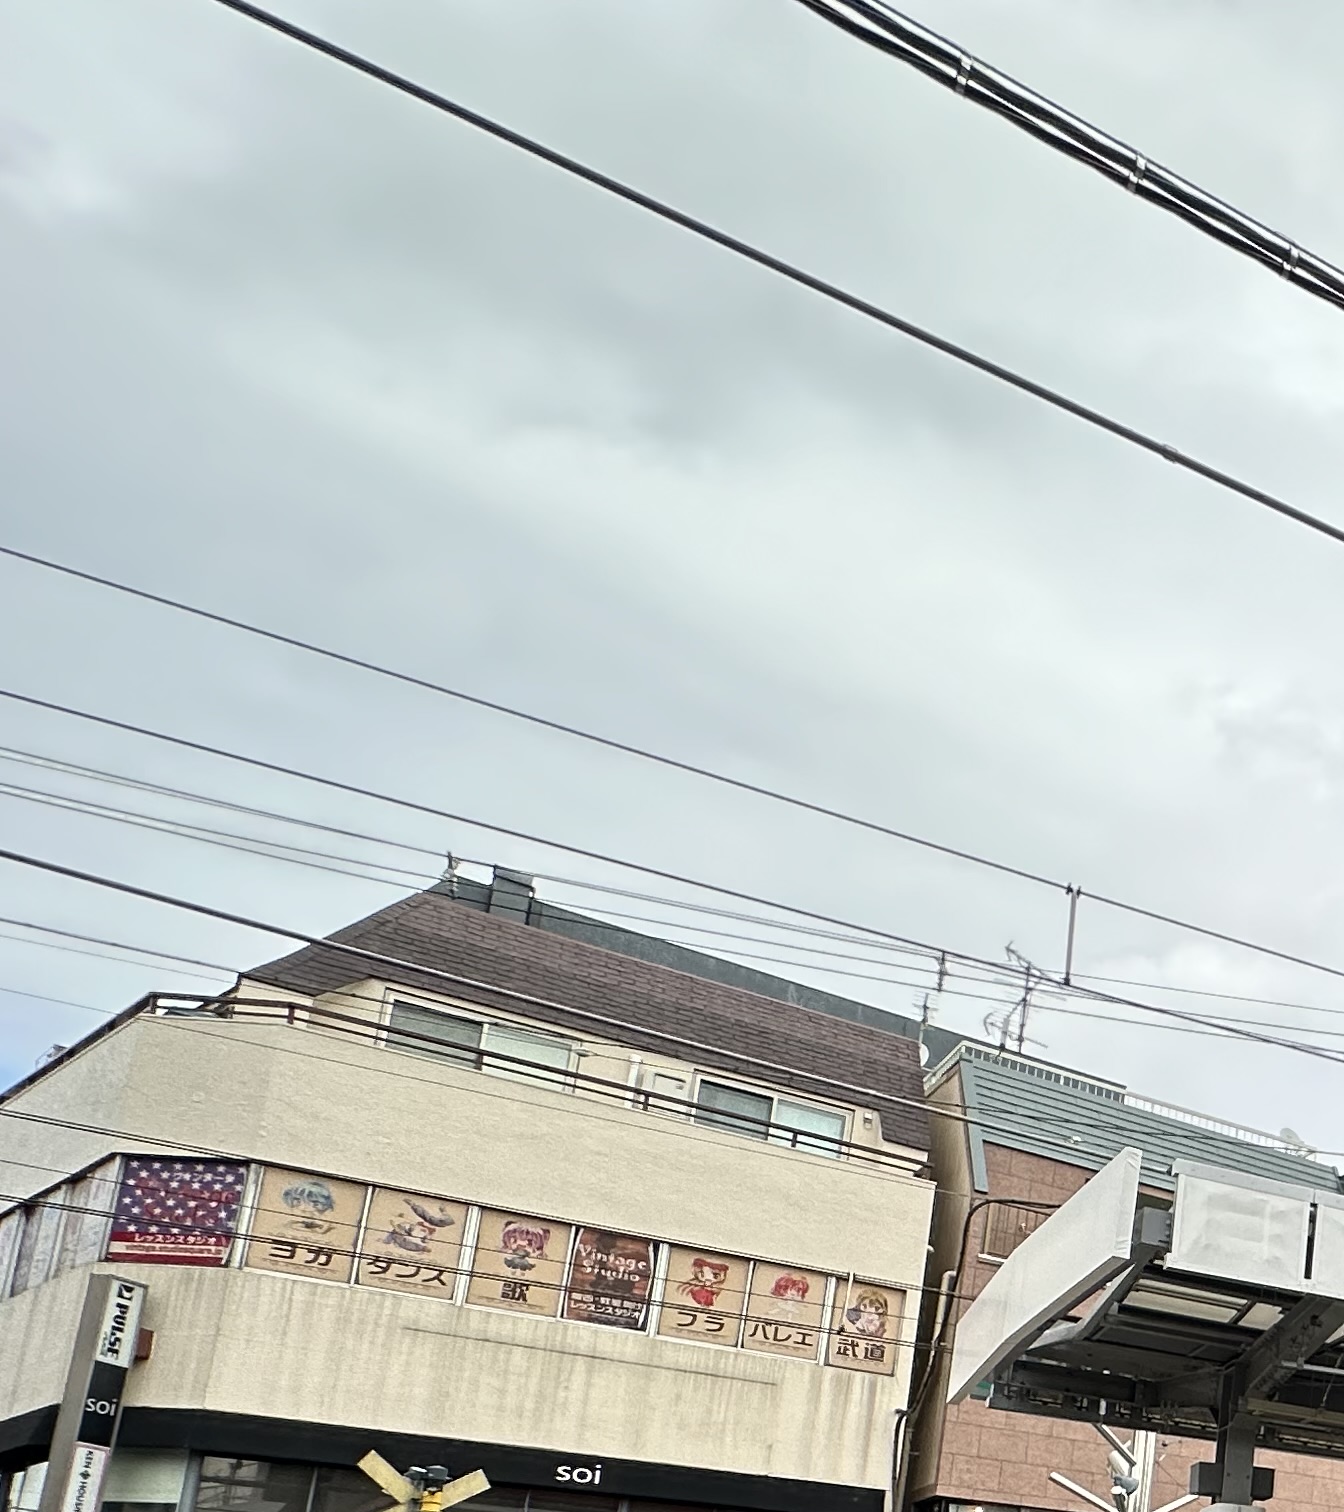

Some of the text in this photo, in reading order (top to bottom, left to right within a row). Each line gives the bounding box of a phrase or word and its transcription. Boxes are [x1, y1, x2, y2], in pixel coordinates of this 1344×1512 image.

[579, 1244, 647, 1271] Vintage
[582, 1260, 640, 1282] Studio
[677, 1311, 725, 1333] フラ
[748, 1322, 814, 1347] バレエ
[836, 1337, 887, 1363] 武道
[85, 1398, 118, 1417] soi
[555, 1464, 602, 1486] soi
